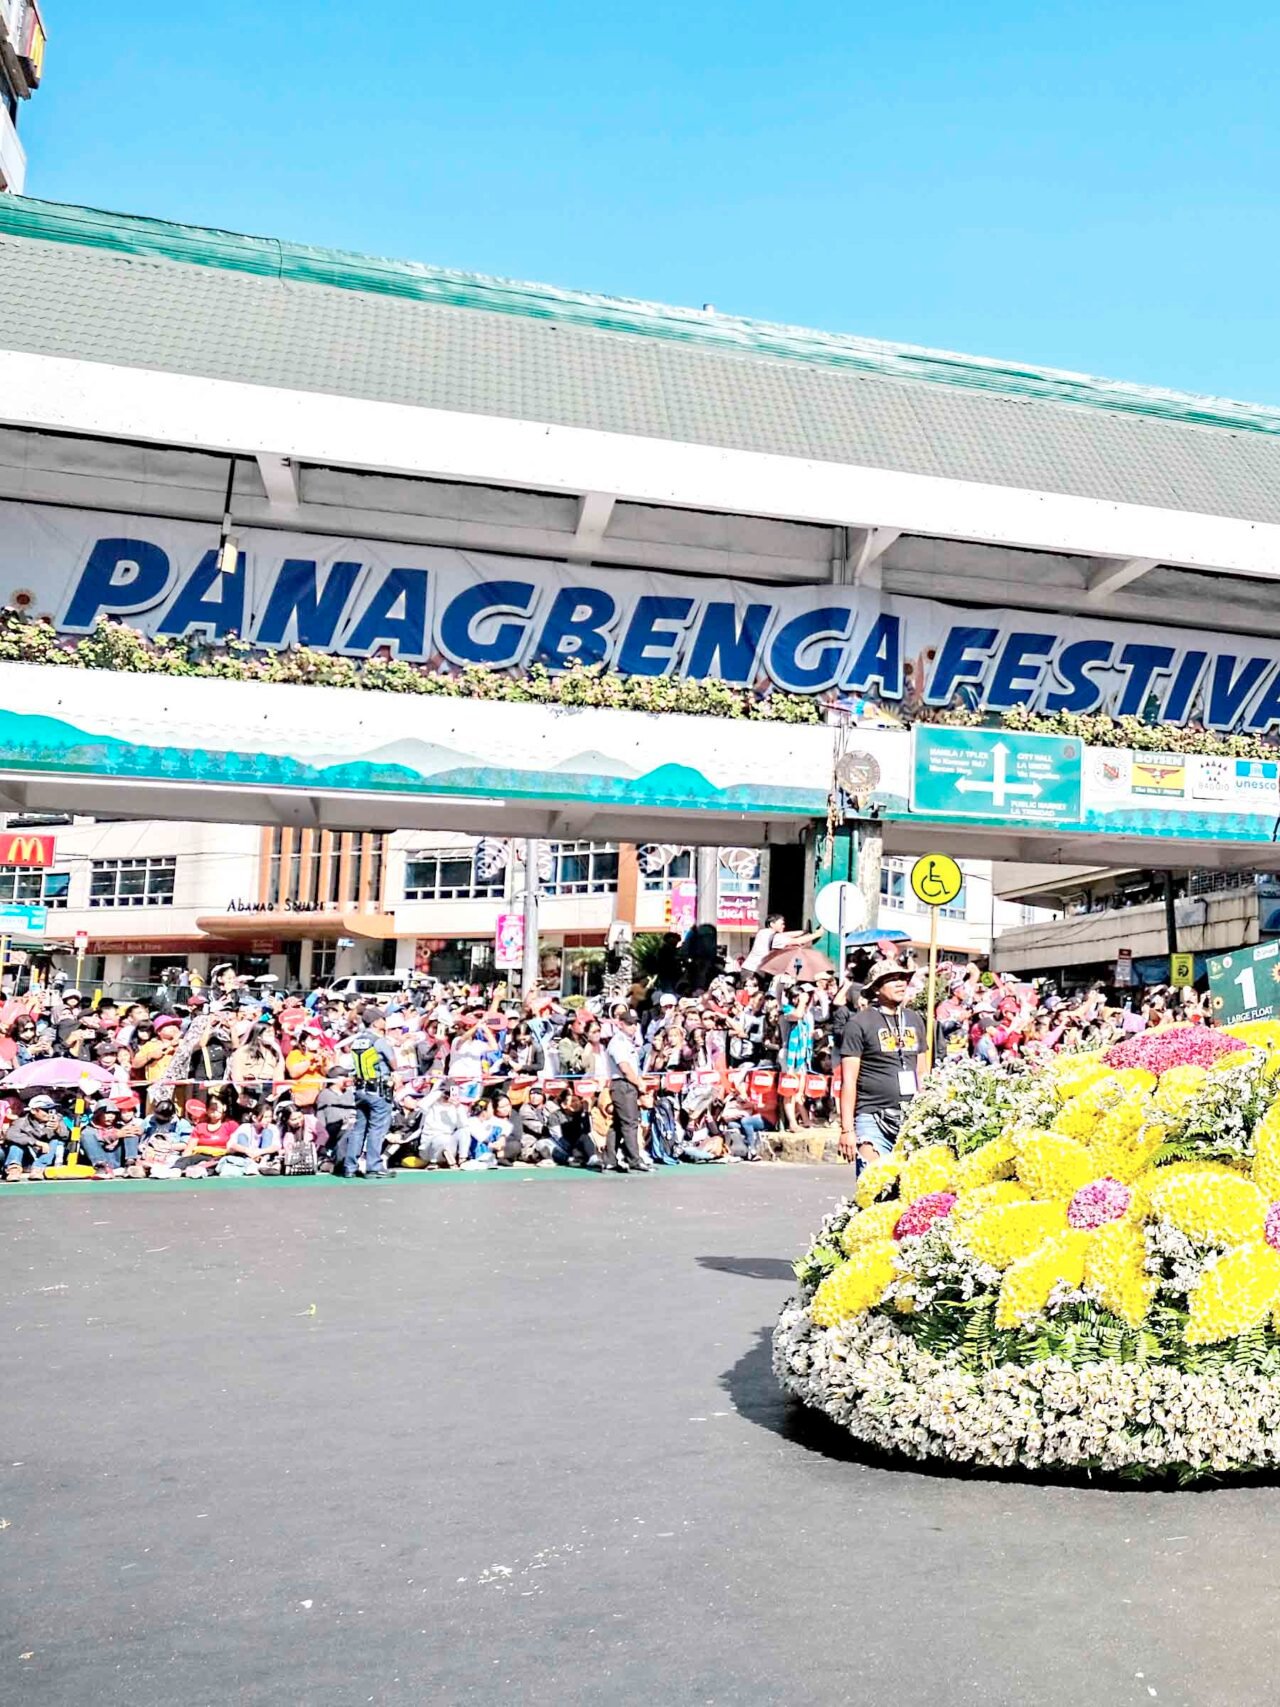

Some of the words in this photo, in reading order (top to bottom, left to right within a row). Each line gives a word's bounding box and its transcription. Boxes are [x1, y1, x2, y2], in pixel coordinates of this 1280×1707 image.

[60, 537, 904, 698] PANAGBENGA
[1135, 753, 1184, 766] BOYSEN
[1236, 779, 1277, 791] unesco
[1234, 966, 1258, 1010] 1
[1227, 1012, 1251, 1025] LARGE
[1251, 1005, 1274, 1018] FLOAT
